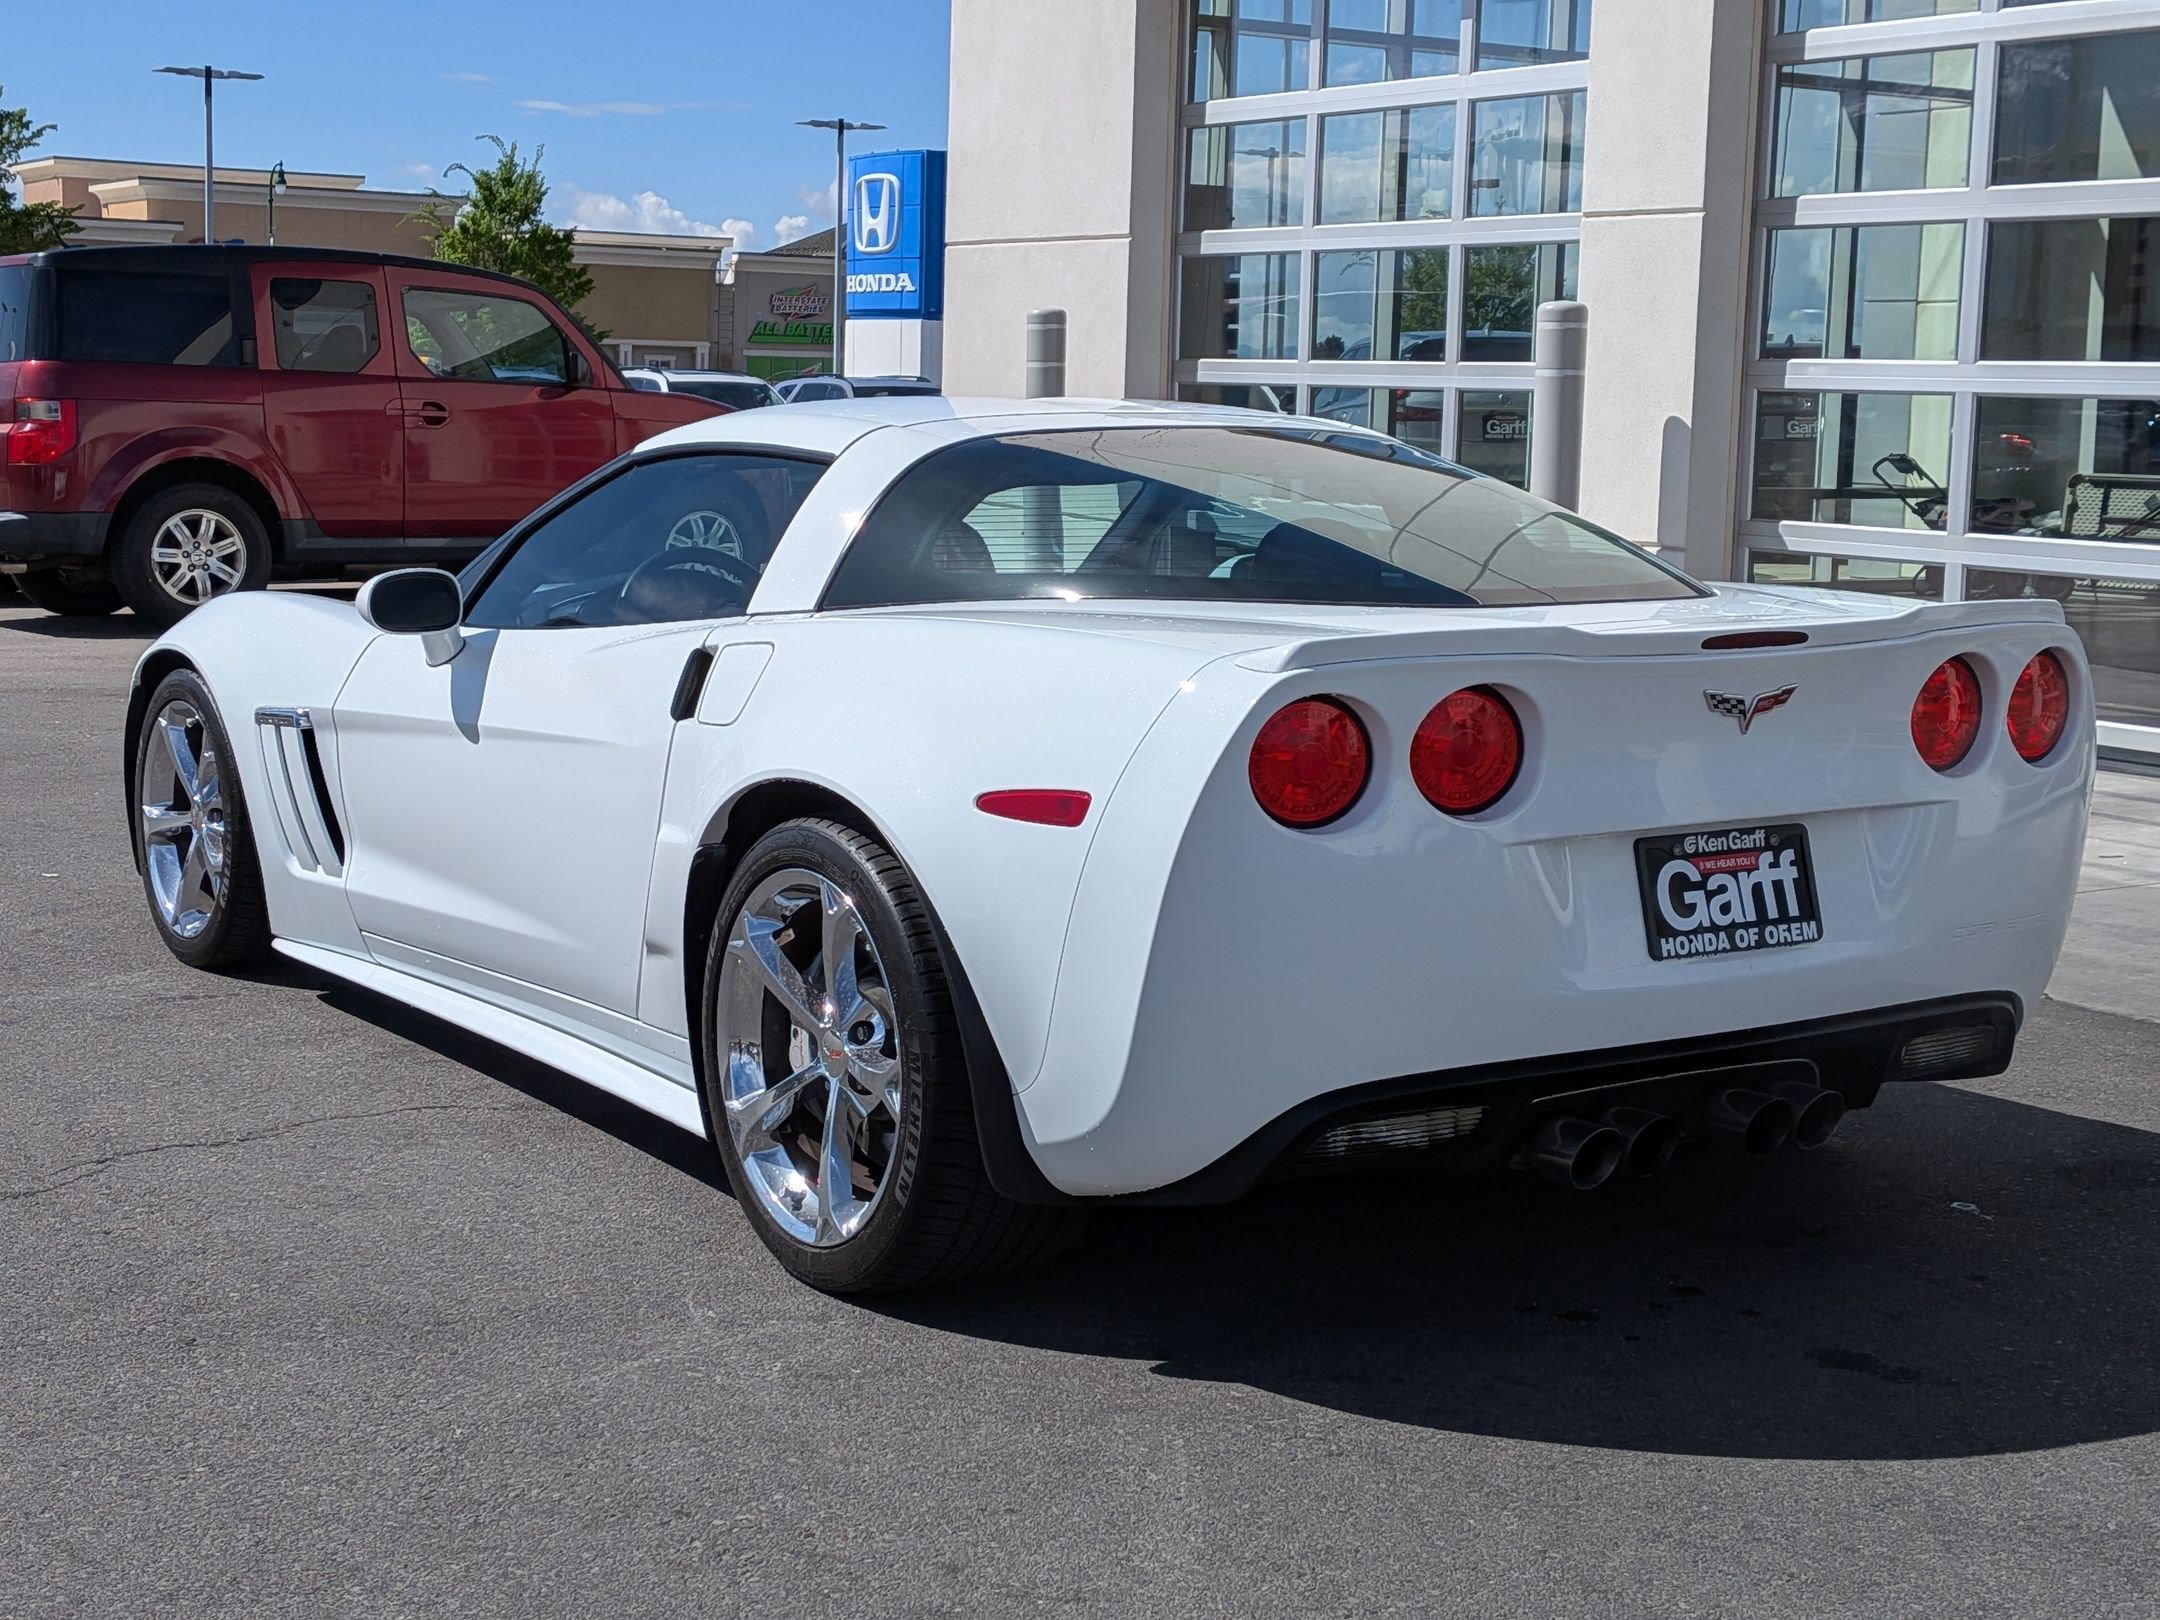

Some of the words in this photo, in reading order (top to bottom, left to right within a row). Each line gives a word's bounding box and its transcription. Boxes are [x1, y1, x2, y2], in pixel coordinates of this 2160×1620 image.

[846, 272, 917, 293] HONDA
[772, 294, 829, 306] INTERSTATE
[754, 321, 781, 335] ALL
[1486, 420, 1527, 434] Garff
[1697, 834, 1728, 853] Ken
[1728, 829, 1766, 850] Garff
[1705, 860, 1717, 869] WE
[1717, 858, 1736, 868] HEAR
[1656, 848, 1800, 931] Garff
[1660, 931, 1731, 957] HONDA
[1735, 927, 1759, 948] OF
[1764, 920, 1818, 945] OREM
[898, 1049, 922, 1198] MICHELIN
